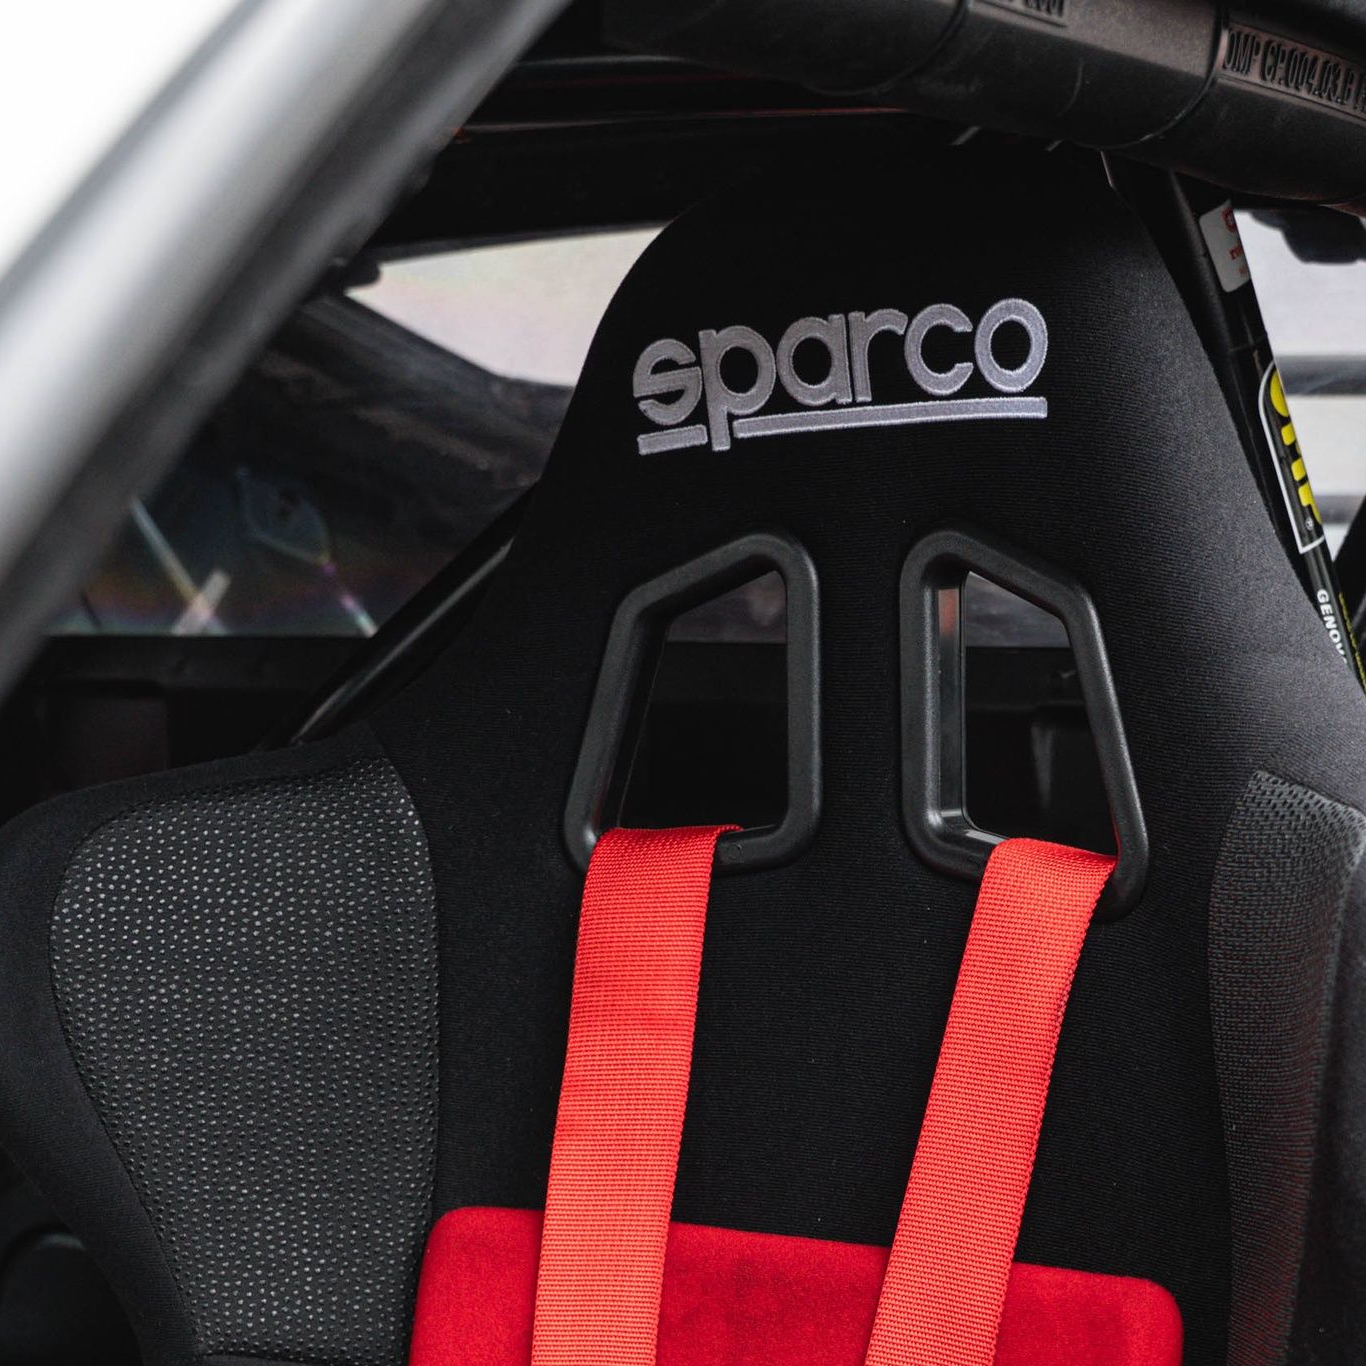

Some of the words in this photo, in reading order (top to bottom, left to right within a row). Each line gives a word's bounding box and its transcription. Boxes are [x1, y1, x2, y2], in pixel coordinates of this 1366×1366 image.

[1223, 28, 1260, 75] OMP
[633, 299, 1048, 451] sparco
[1317, 589, 1348, 664] GENOV
